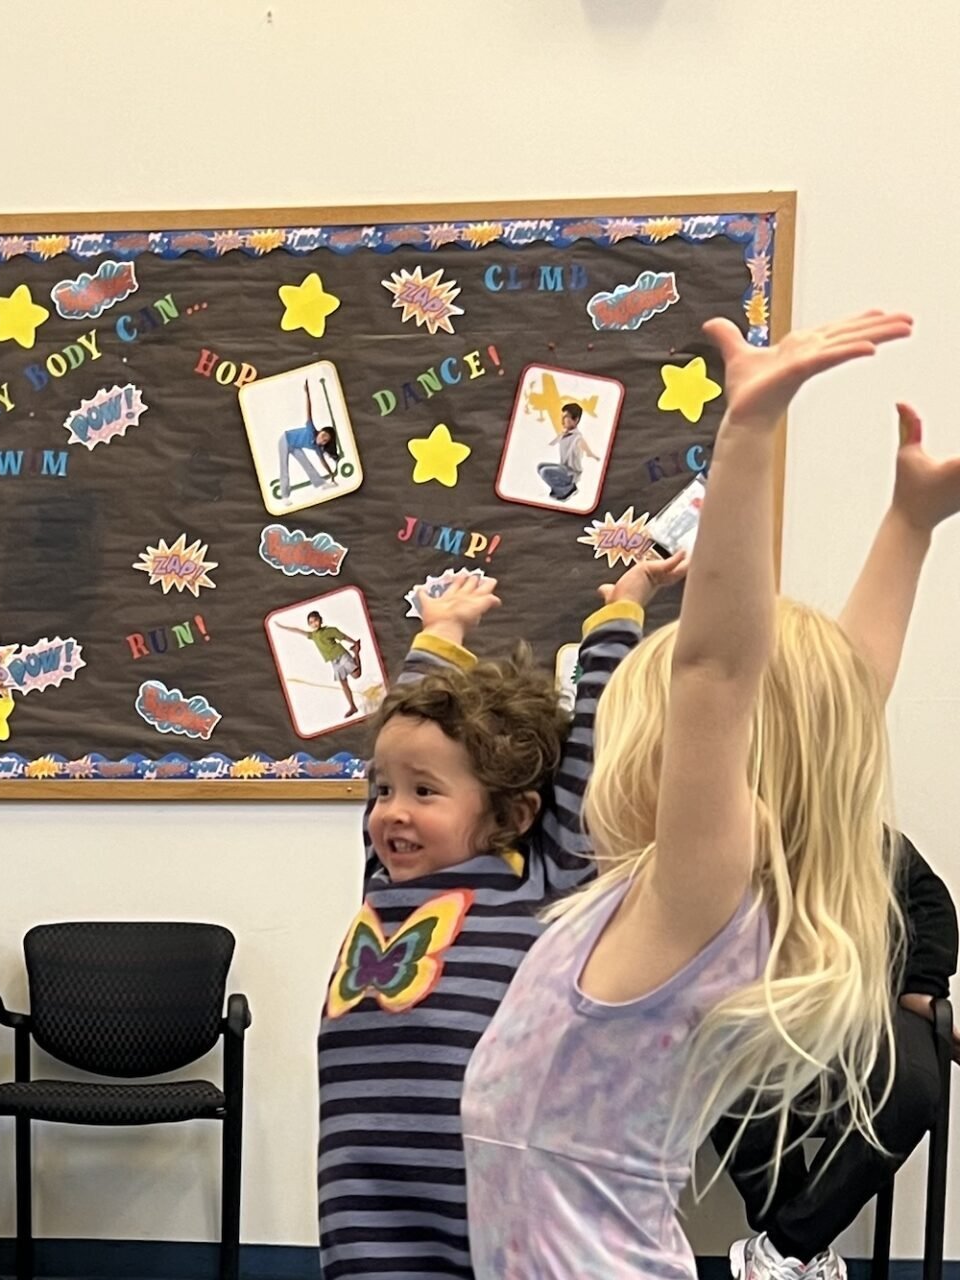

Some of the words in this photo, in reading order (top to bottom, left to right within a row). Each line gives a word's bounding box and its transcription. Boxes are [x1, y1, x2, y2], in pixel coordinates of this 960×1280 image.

[484, 264, 589, 292] CLMB
[398, 281, 453, 324] ZAP!
[23, 329, 103, 392] BODY
[193, 348, 258, 388] HOP
[372, 344, 505, 417] DANCE!
[69, 387, 136, 442] POW!
[645, 444, 710, 483] KIC
[396, 515, 502, 563] JUMP!
[598, 527, 655, 560] ZAP!
[151, 554, 204, 584] ZAP!
[125, 614, 212, 660] RUN!
[7, 641, 75, 687] POW!
